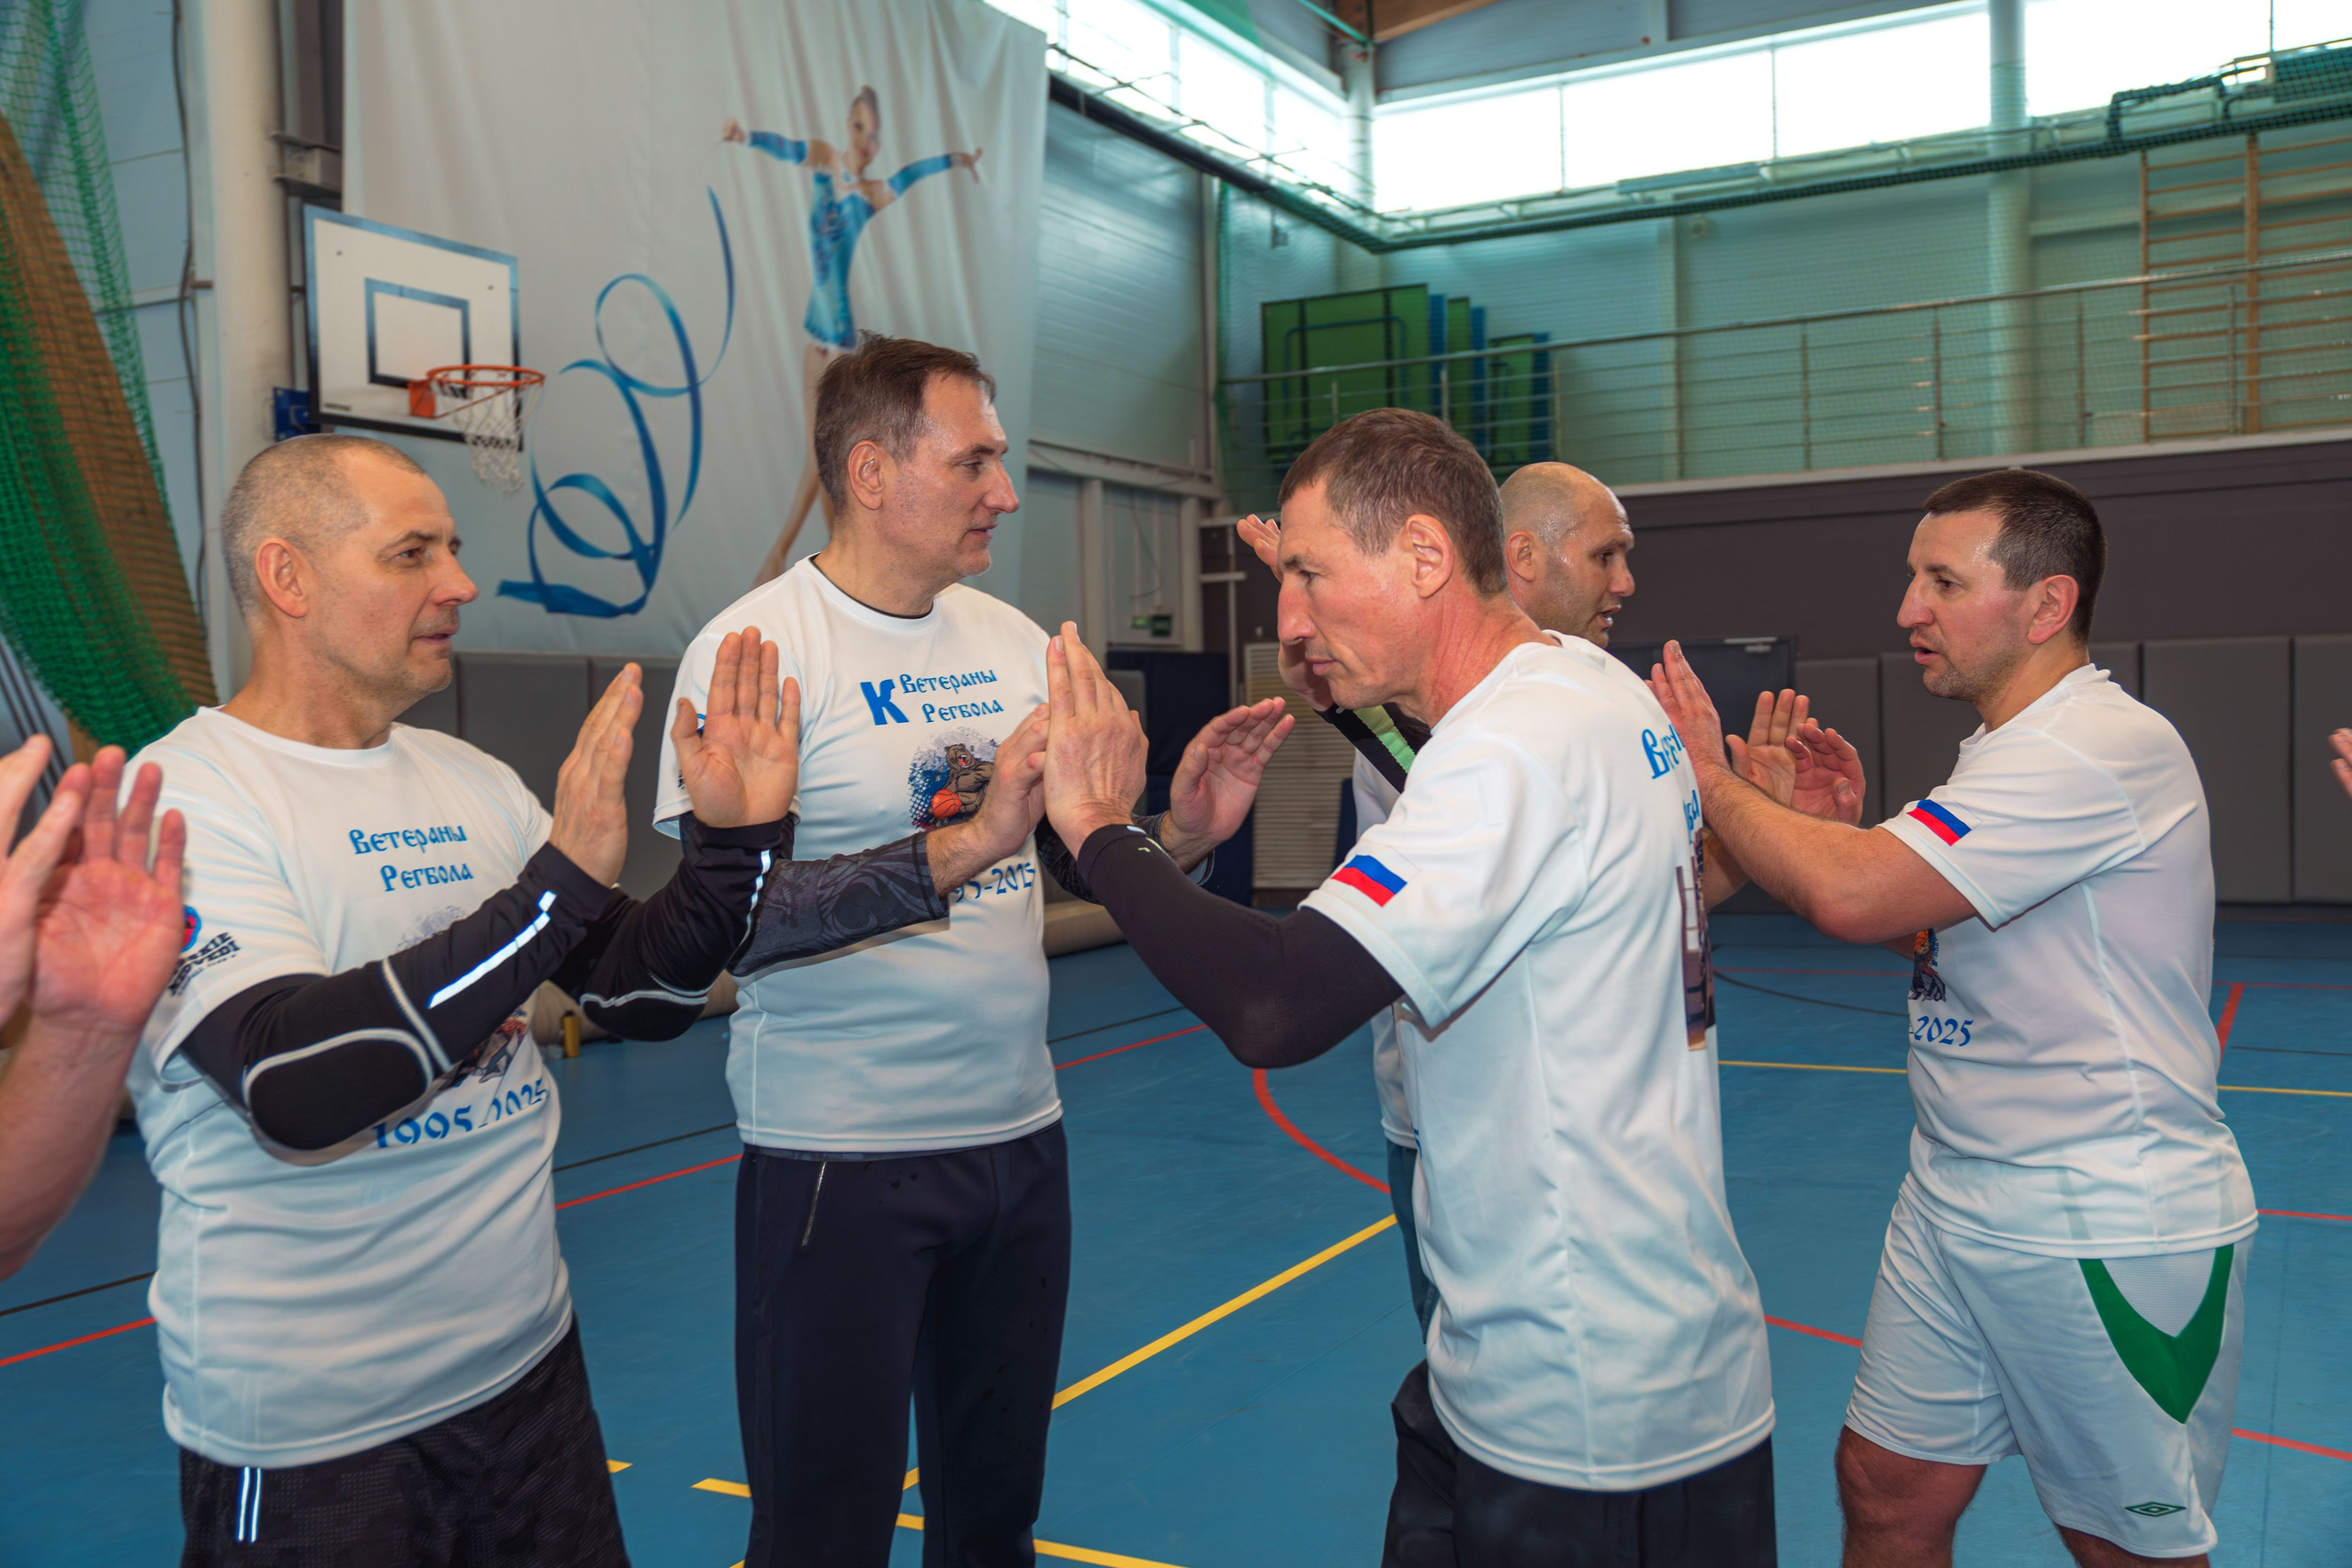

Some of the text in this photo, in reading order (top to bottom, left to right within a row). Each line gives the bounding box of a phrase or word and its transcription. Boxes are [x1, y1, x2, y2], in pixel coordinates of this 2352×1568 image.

[899, 670, 998, 695] Ветераны
[922, 699, 1004, 723] Регбола
[348, 825, 469, 855] Ветераны
[380, 863, 474, 892] Регбола
